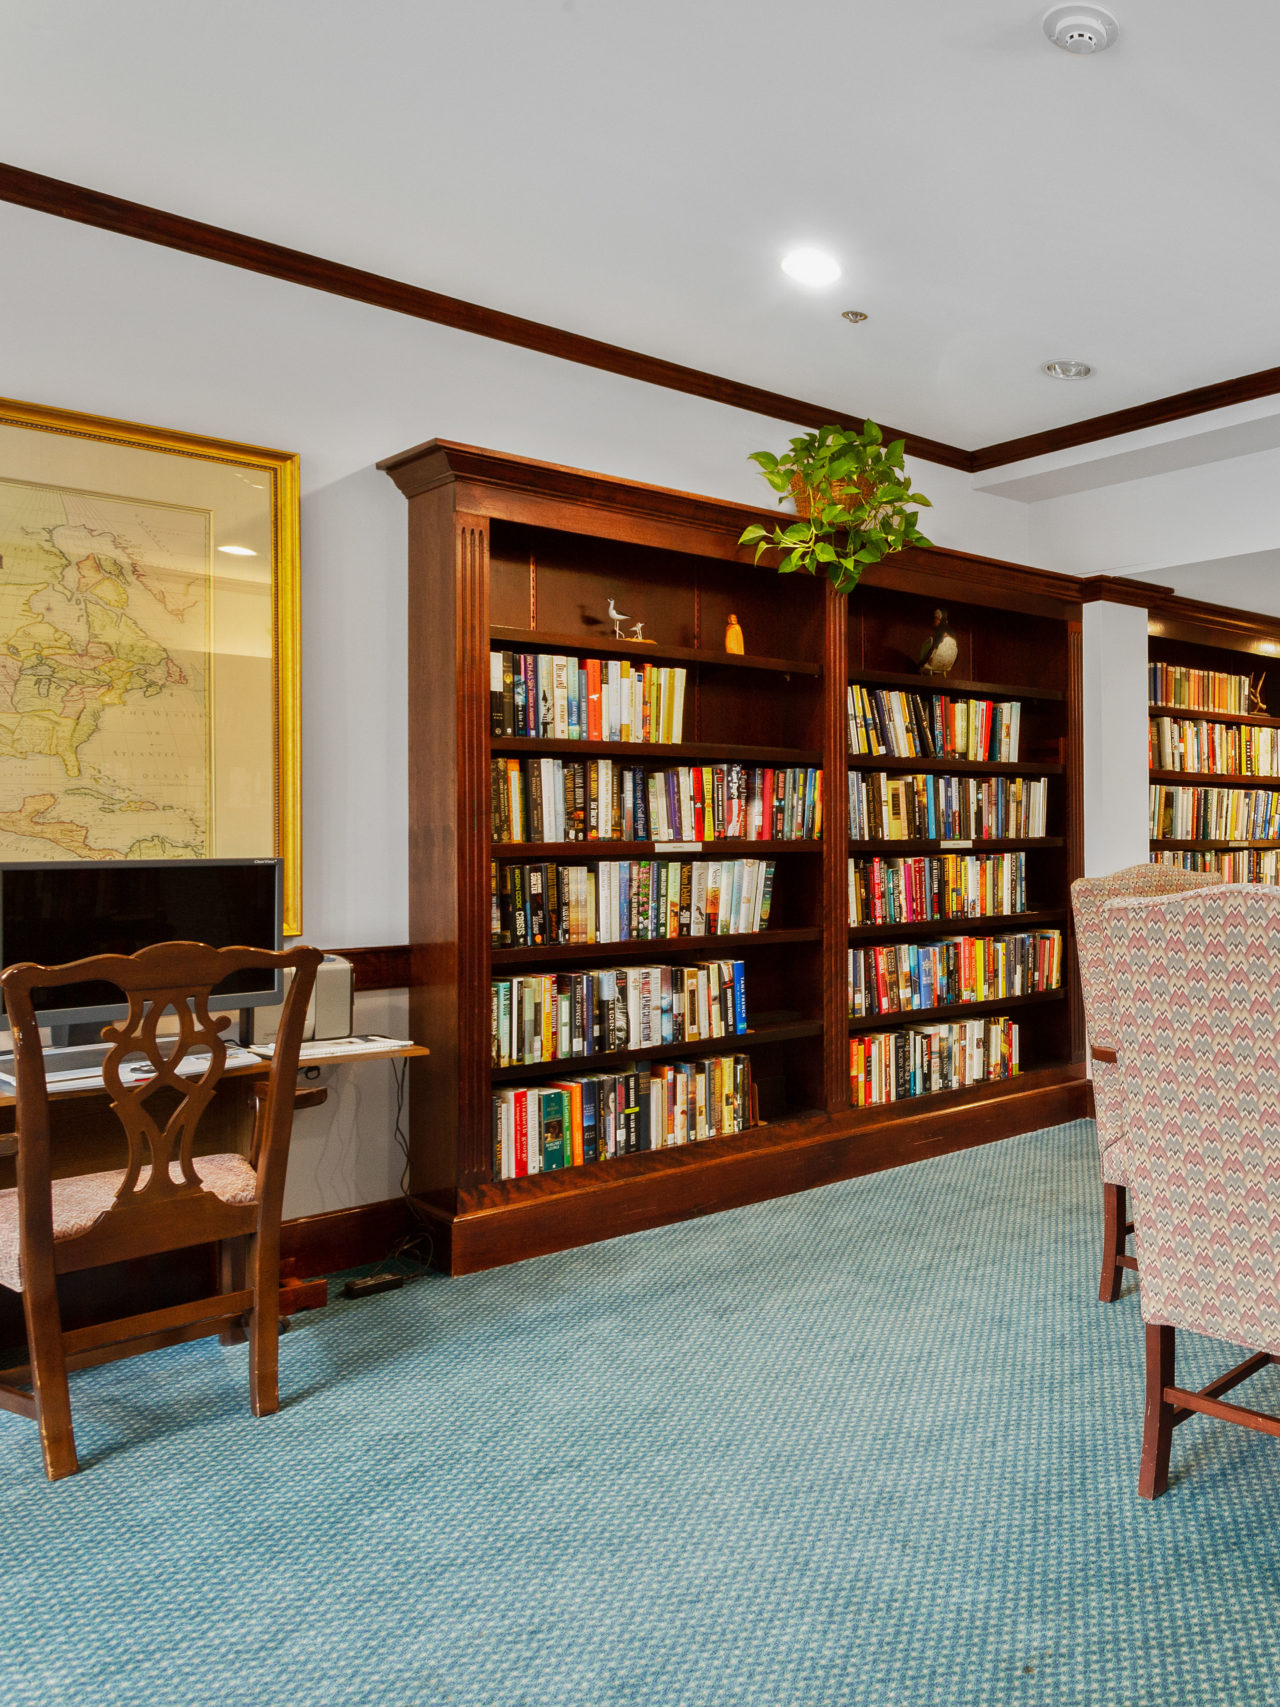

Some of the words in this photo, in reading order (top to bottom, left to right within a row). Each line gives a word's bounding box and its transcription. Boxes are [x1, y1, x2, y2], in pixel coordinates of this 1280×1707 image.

[565, 770, 574, 791] SANDRA
[575, 765, 584, 787] SANDRA
[565, 792, 574, 812] BROWN
[575, 788, 584, 808] BROWN
[681, 864, 691, 885] Nelson
[696, 872, 705, 887] Nelson
[710, 868, 721, 886] Nelson
[681, 885, 691, 907] DeMille
[696, 887, 705, 904] DeMille
[710, 886, 721, 907] DeMille
[516, 911, 525, 936] CRISIS
